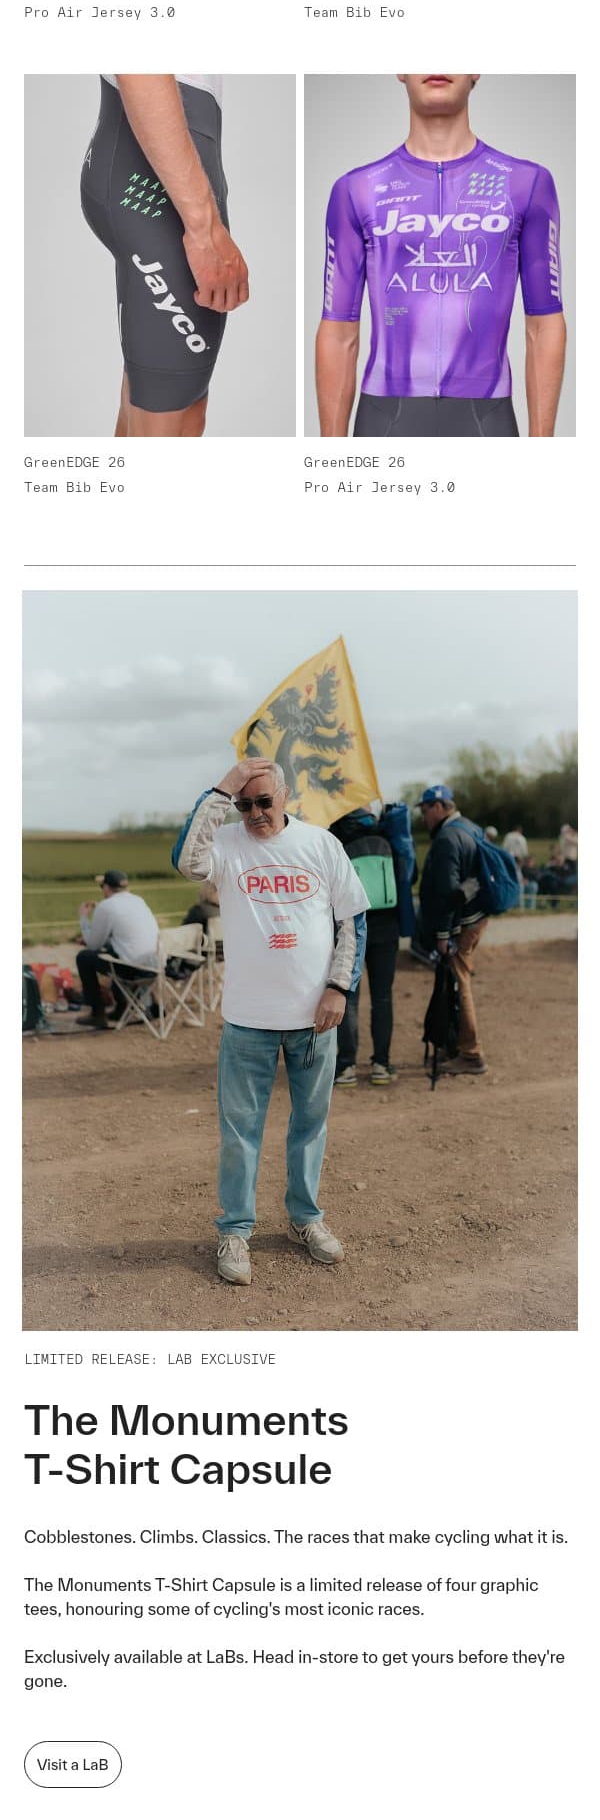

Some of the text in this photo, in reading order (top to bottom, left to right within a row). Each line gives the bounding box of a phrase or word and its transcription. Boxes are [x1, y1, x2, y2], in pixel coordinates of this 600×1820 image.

[25, 7, 175, 20] Pro Air Jersey 3.0
[304, 7, 404, 17] Team Bib Evo
[129, 173, 168, 193] MAA
[124, 185, 168, 206] MAAP
[119, 197, 162, 218] MAAP
[373, 210, 510, 238] Jayco
[385, 271, 493, 294] ALULA
[132, 253, 207, 353] Jayco
[24, 457, 125, 468] GreenEDGE 26
[304, 457, 405, 468] GreenEDGE 26
[24, 482, 124, 492] Team Bib Evo
[246, 874, 311, 894] PARIS
[26, 1353, 275, 1364] LIMITED RELEASE: LAB EXCLUSIVE
[24, 1405, 348, 1436] The Monuments
[24, 1454, 331, 1492] T-Shirt Capsule
[25, 1529, 567, 1546] Cobblestones. Climbs. Classics. The races that make cycling what it is.
[37, 1758, 108, 1770] Visit a LaB
